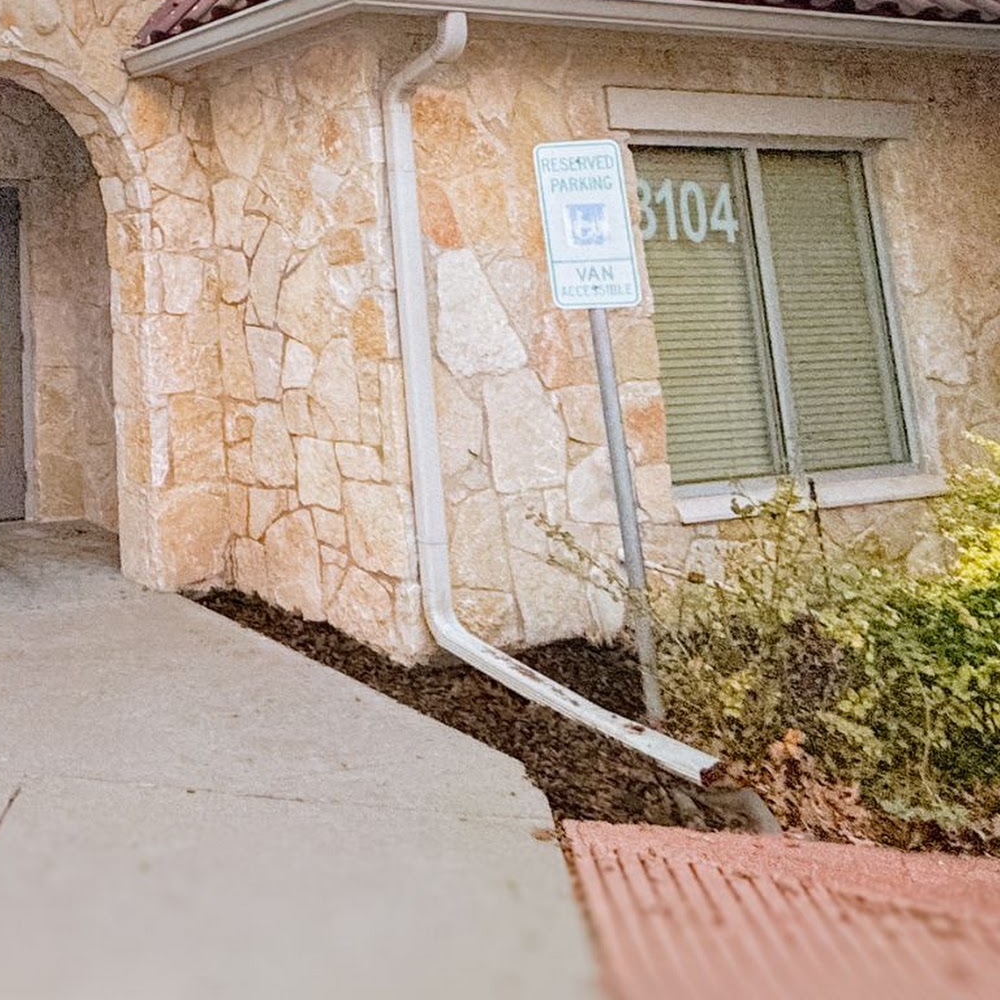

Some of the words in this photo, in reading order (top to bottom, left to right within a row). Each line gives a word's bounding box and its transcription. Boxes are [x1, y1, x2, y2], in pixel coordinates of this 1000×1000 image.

[541, 154, 614, 173] RESERVED
[550, 175, 613, 194] PARKING
[575, 265, 614, 282] VAN
